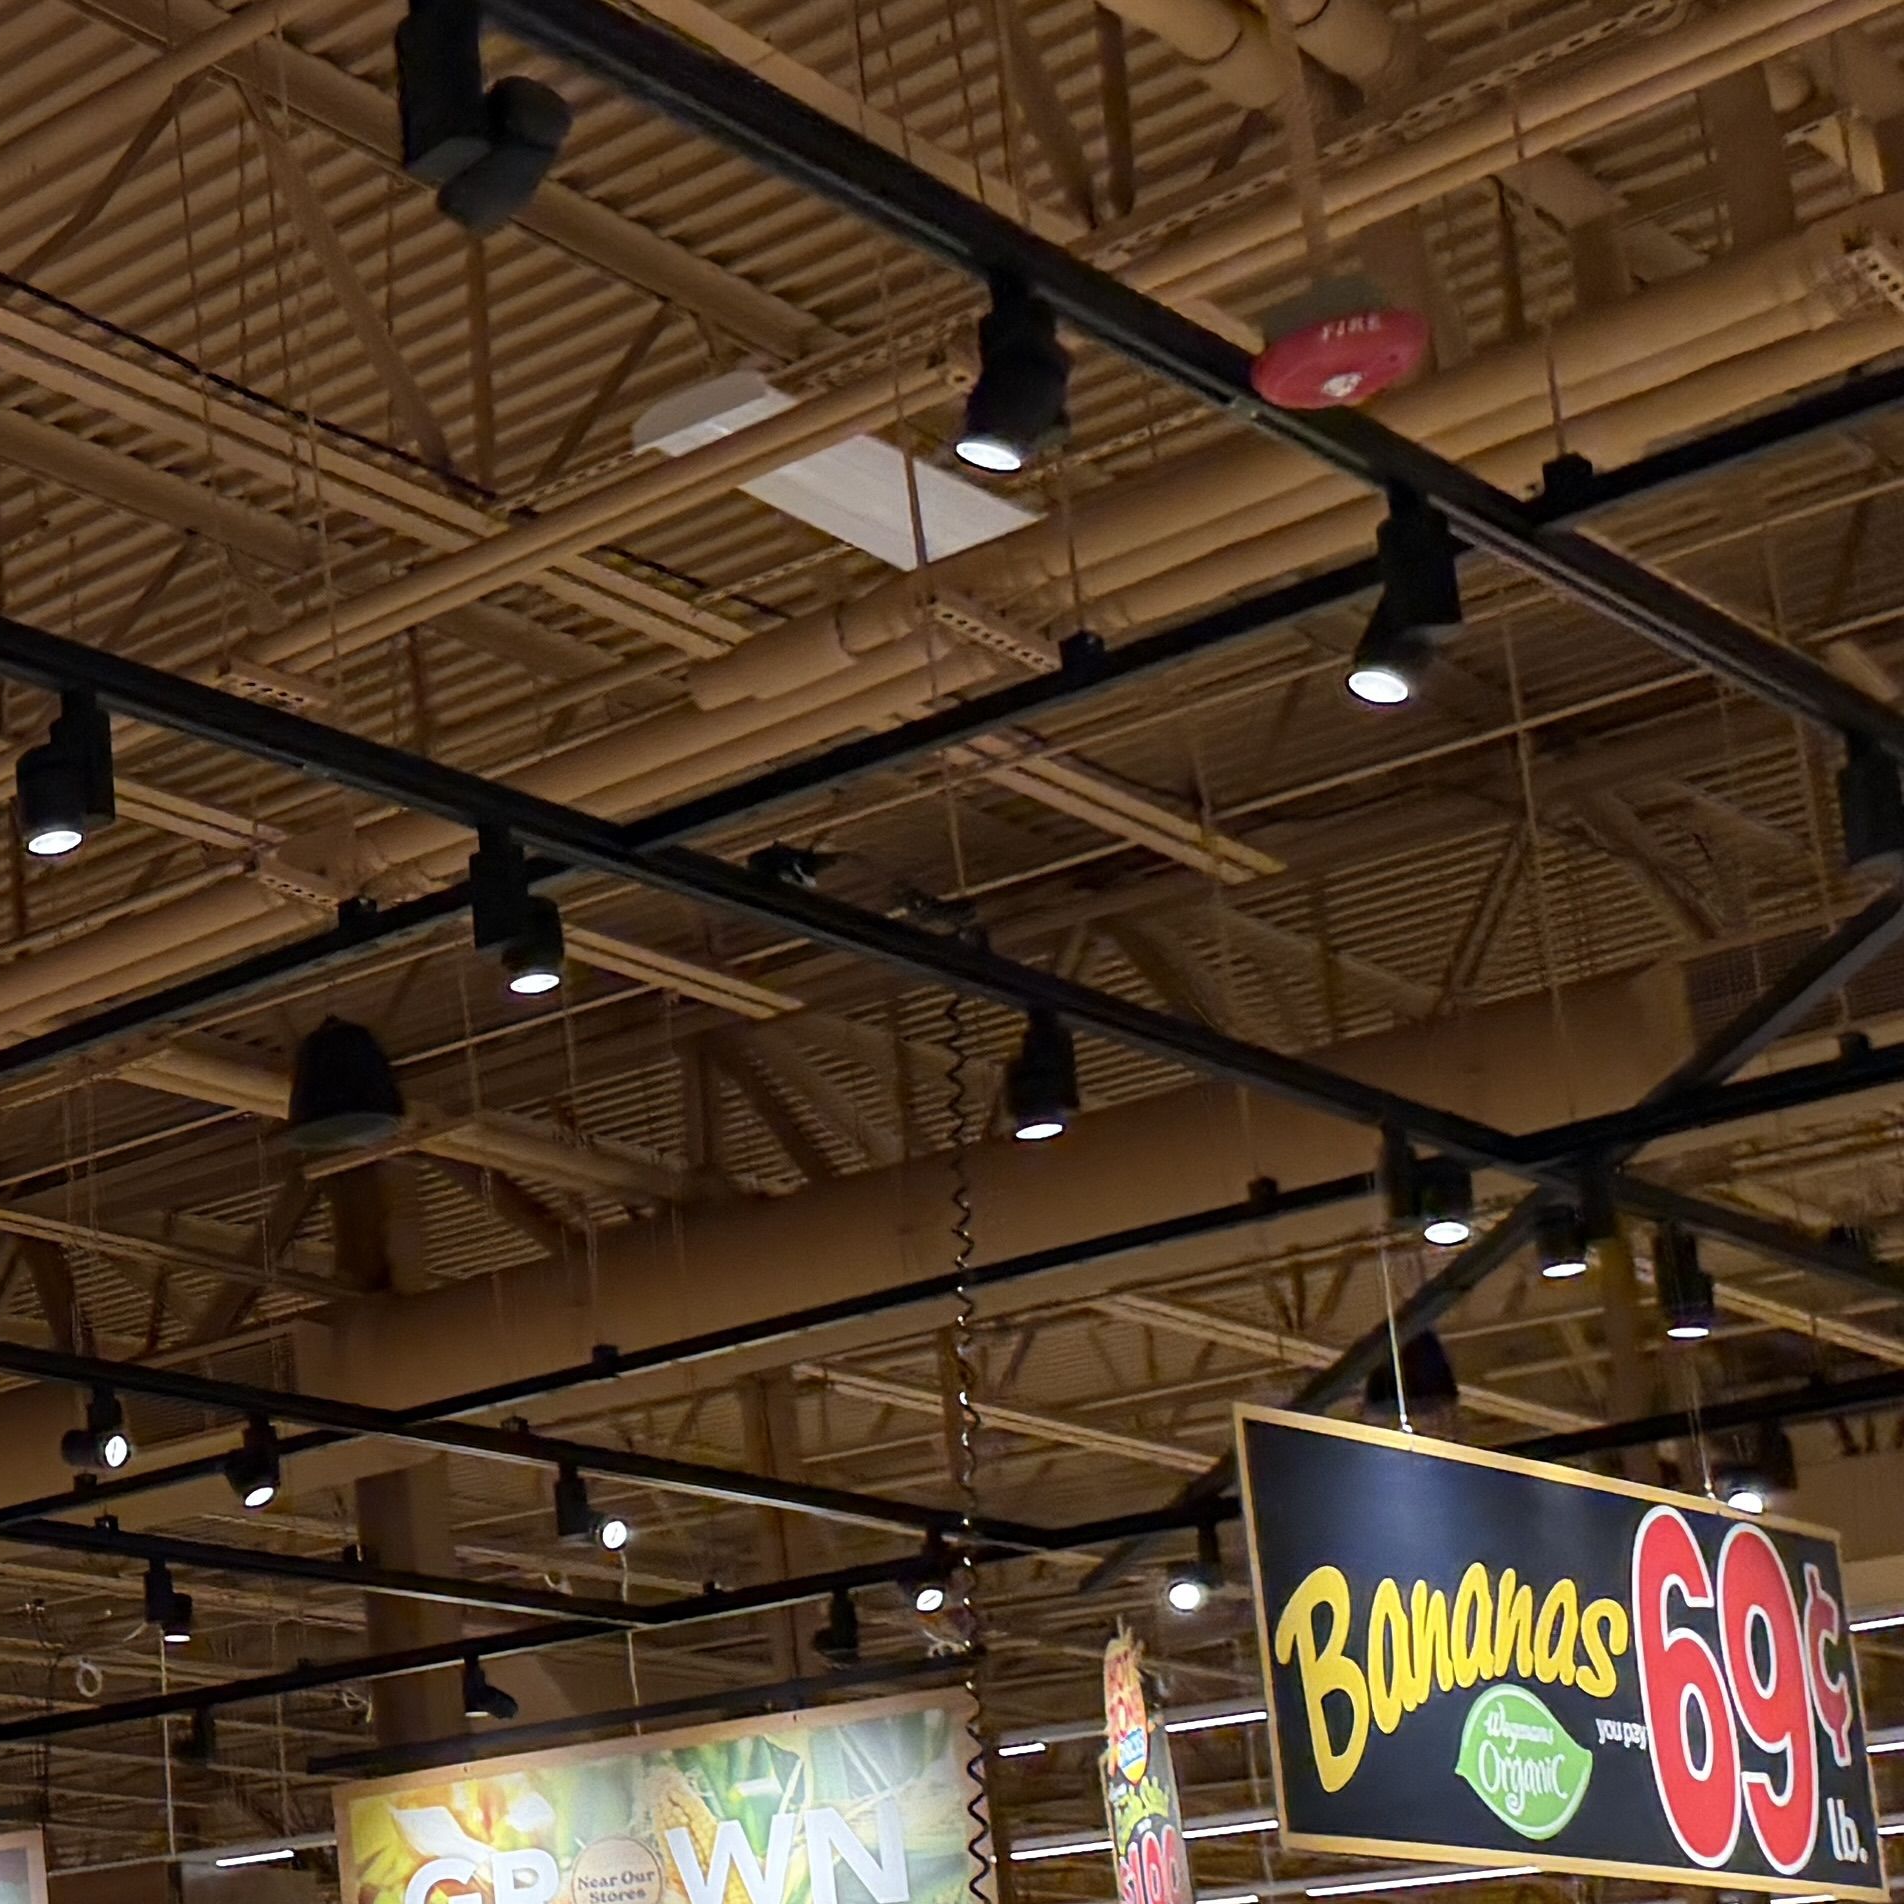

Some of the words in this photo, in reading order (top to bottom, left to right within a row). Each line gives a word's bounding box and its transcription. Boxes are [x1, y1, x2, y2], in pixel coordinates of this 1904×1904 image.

[1320, 312, 1381, 343] FIRE
[1275, 1562, 1629, 1794] Bananas
[1633, 1504, 1854, 1877] 69¢
[1595, 1717, 1623, 1745] you
[1478, 1739, 1569, 1817] Organic
[1827, 1796, 1870, 1865] lb.
[577, 1874, 618, 1890] Near
[620, 1869, 656, 1887] Our
[588, 1886, 648, 1904] Stores
